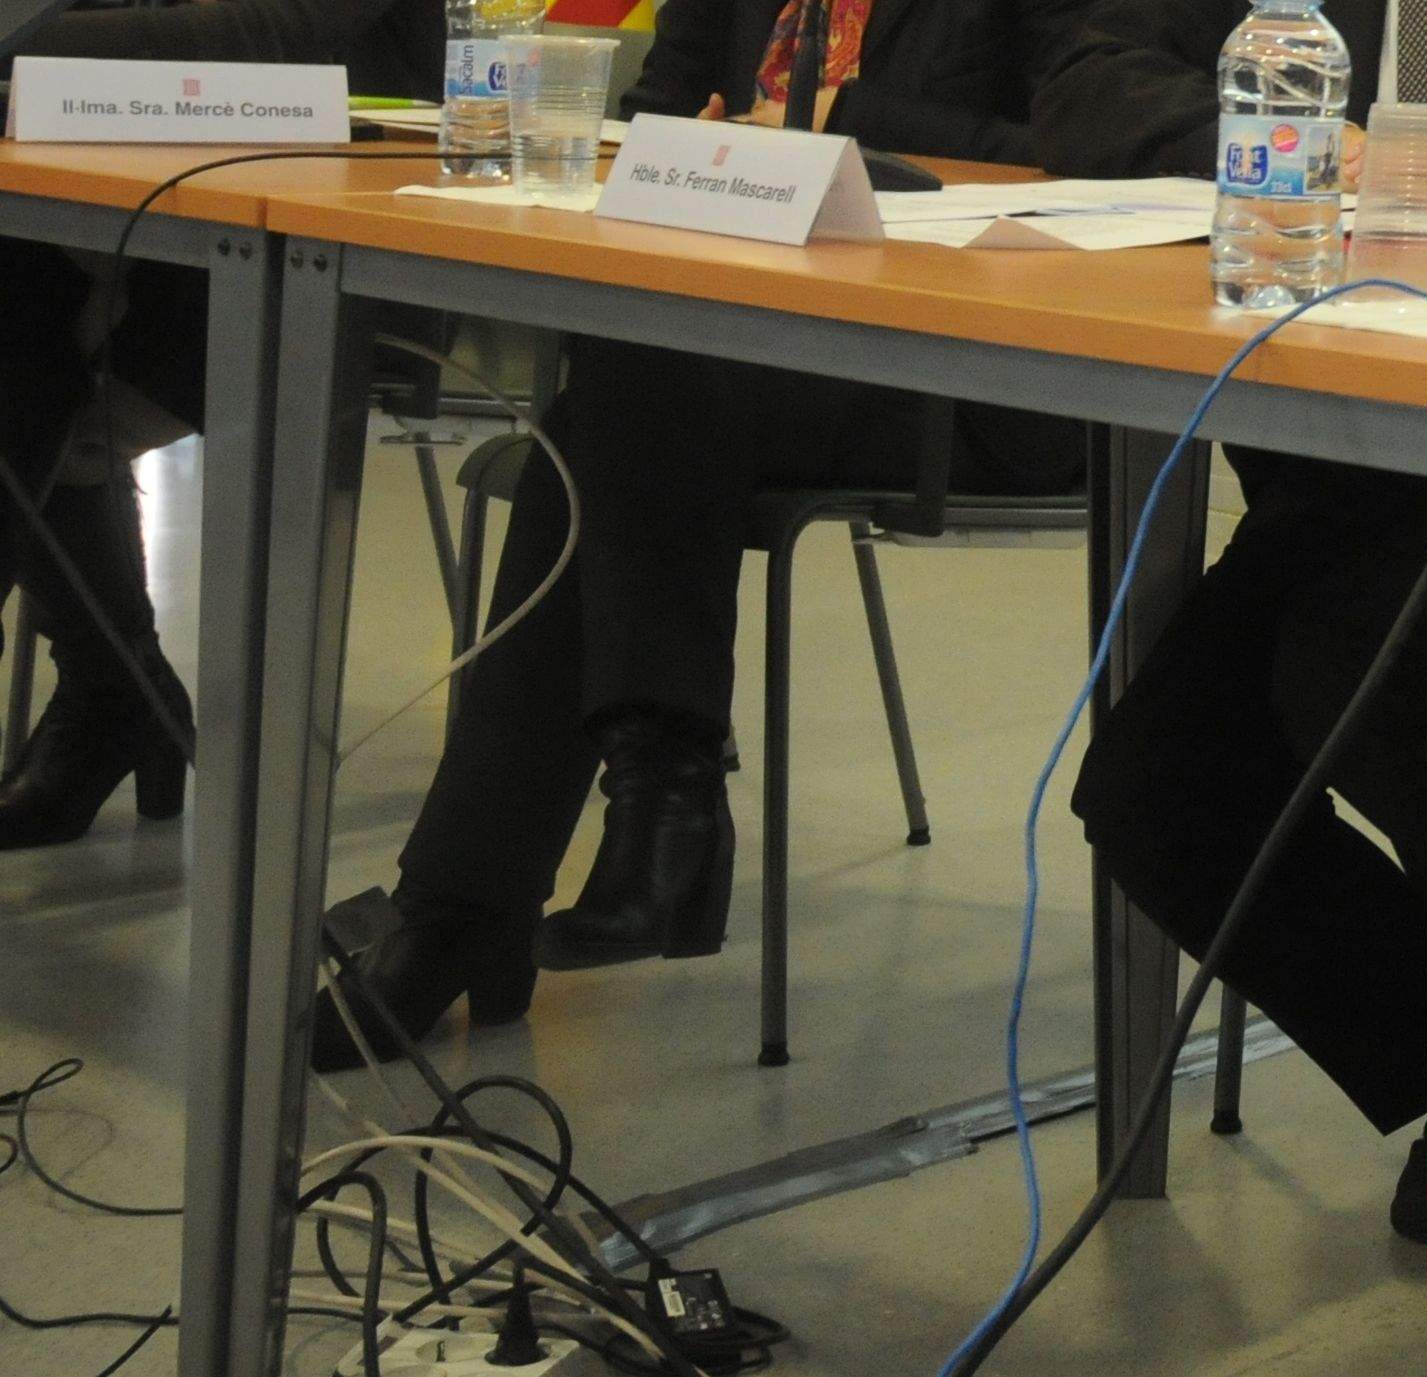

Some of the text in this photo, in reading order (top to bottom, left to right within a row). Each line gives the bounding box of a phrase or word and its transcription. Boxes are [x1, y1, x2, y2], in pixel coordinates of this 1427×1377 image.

[129, 100, 168, 116] Sra.
[175, 101, 234, 117] Mercè
[240, 102, 313, 118] Conesa
[630, 163, 799, 204] Hble. Sr. Ferran Mascarell
